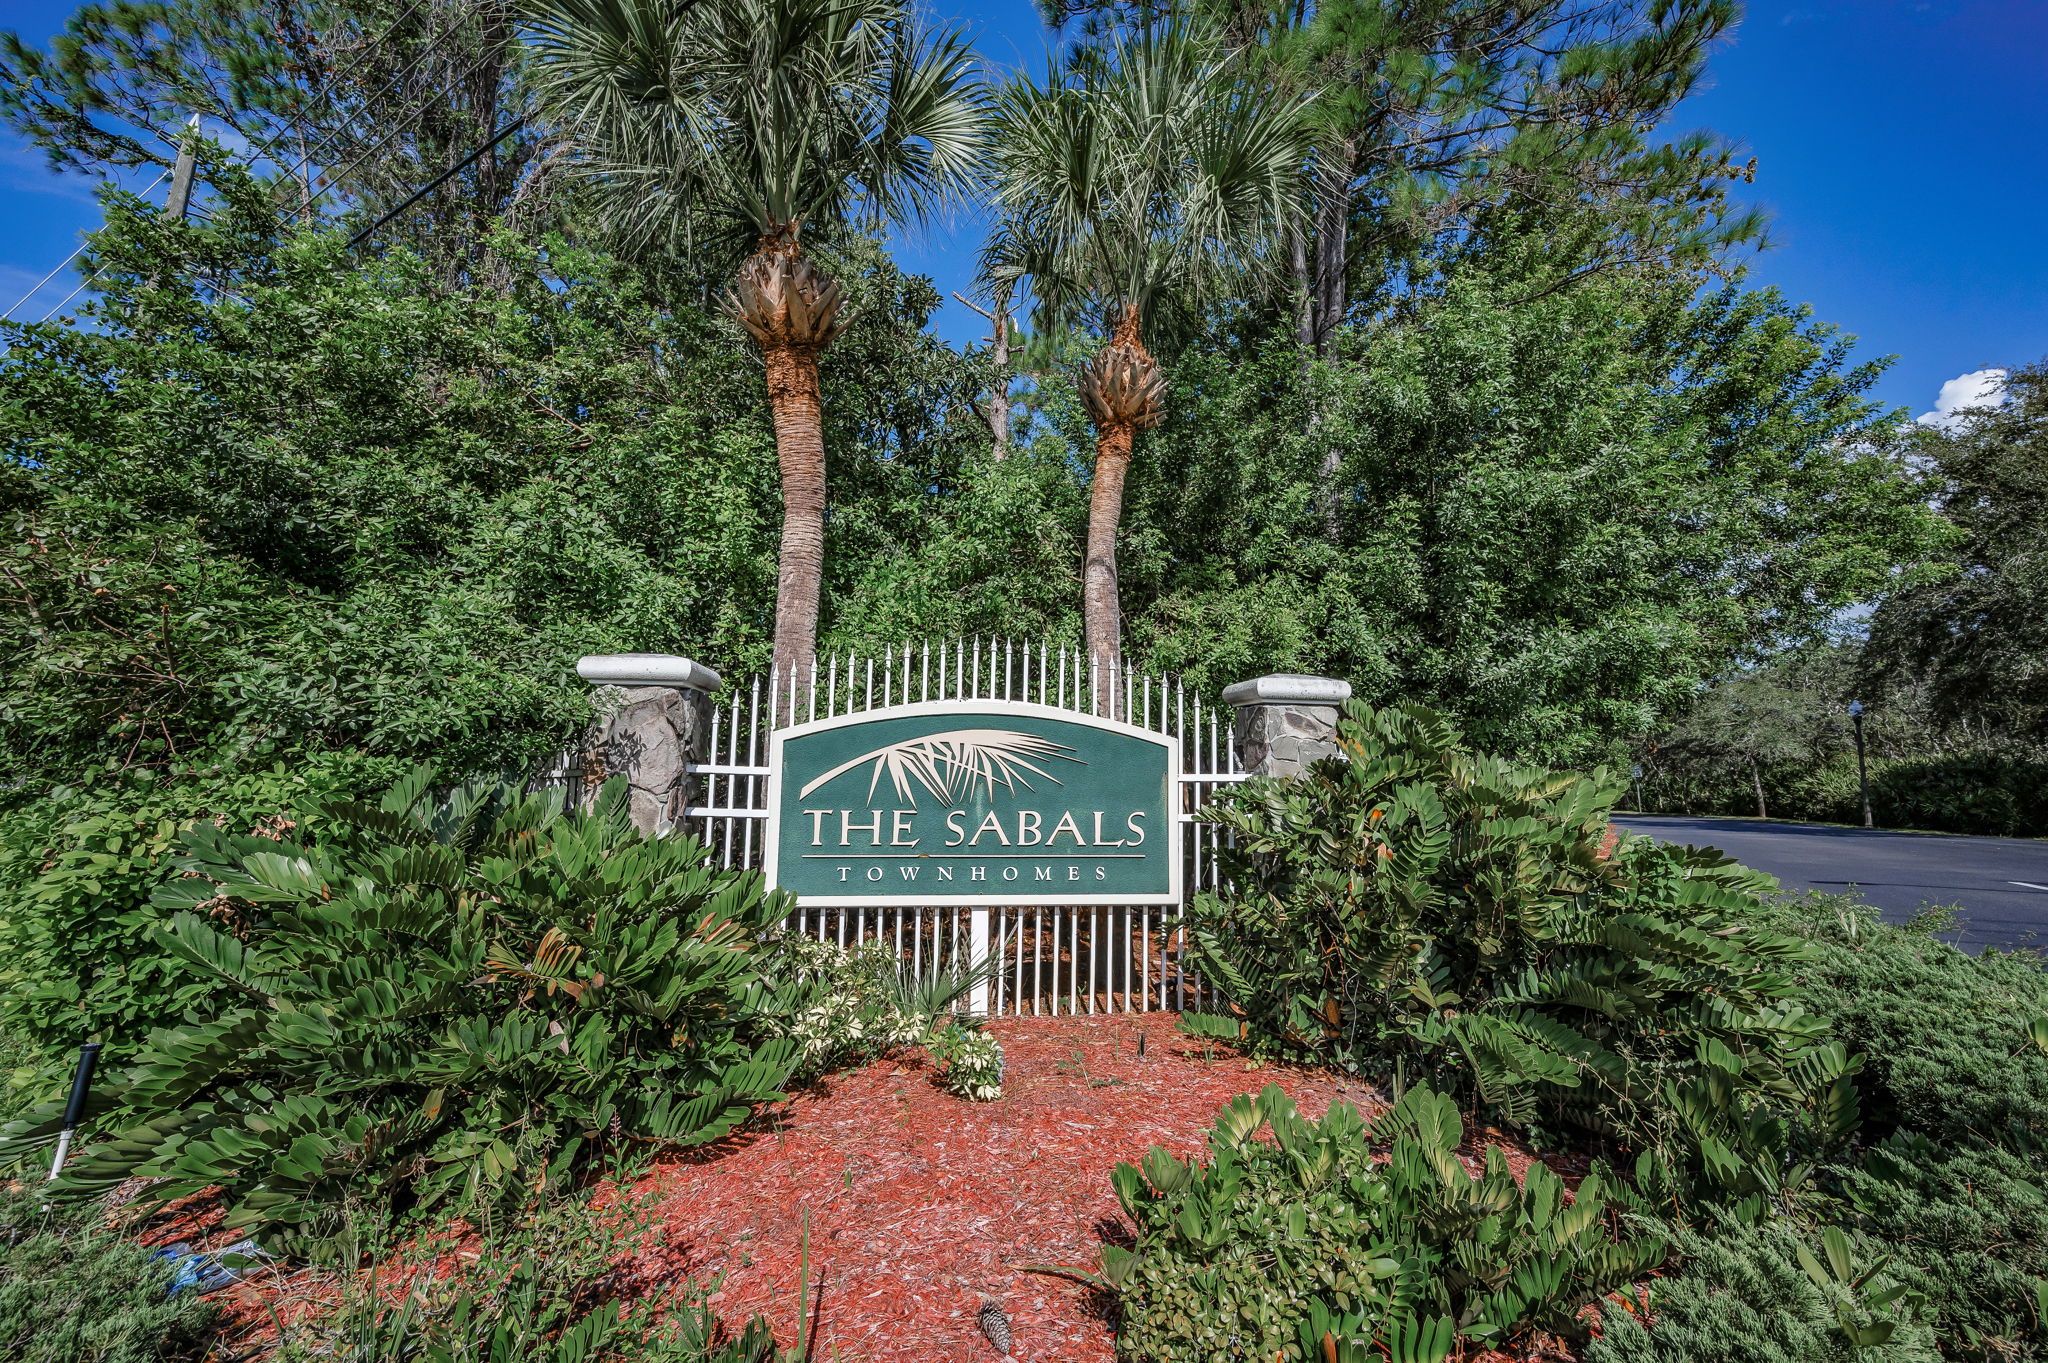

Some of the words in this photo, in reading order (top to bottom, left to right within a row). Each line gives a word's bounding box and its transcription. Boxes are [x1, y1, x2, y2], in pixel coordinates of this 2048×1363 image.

[803, 809, 919, 847] THE
[945, 809, 1146, 847] SABALS
[836, 866, 1106, 882] TOWNHOMES
